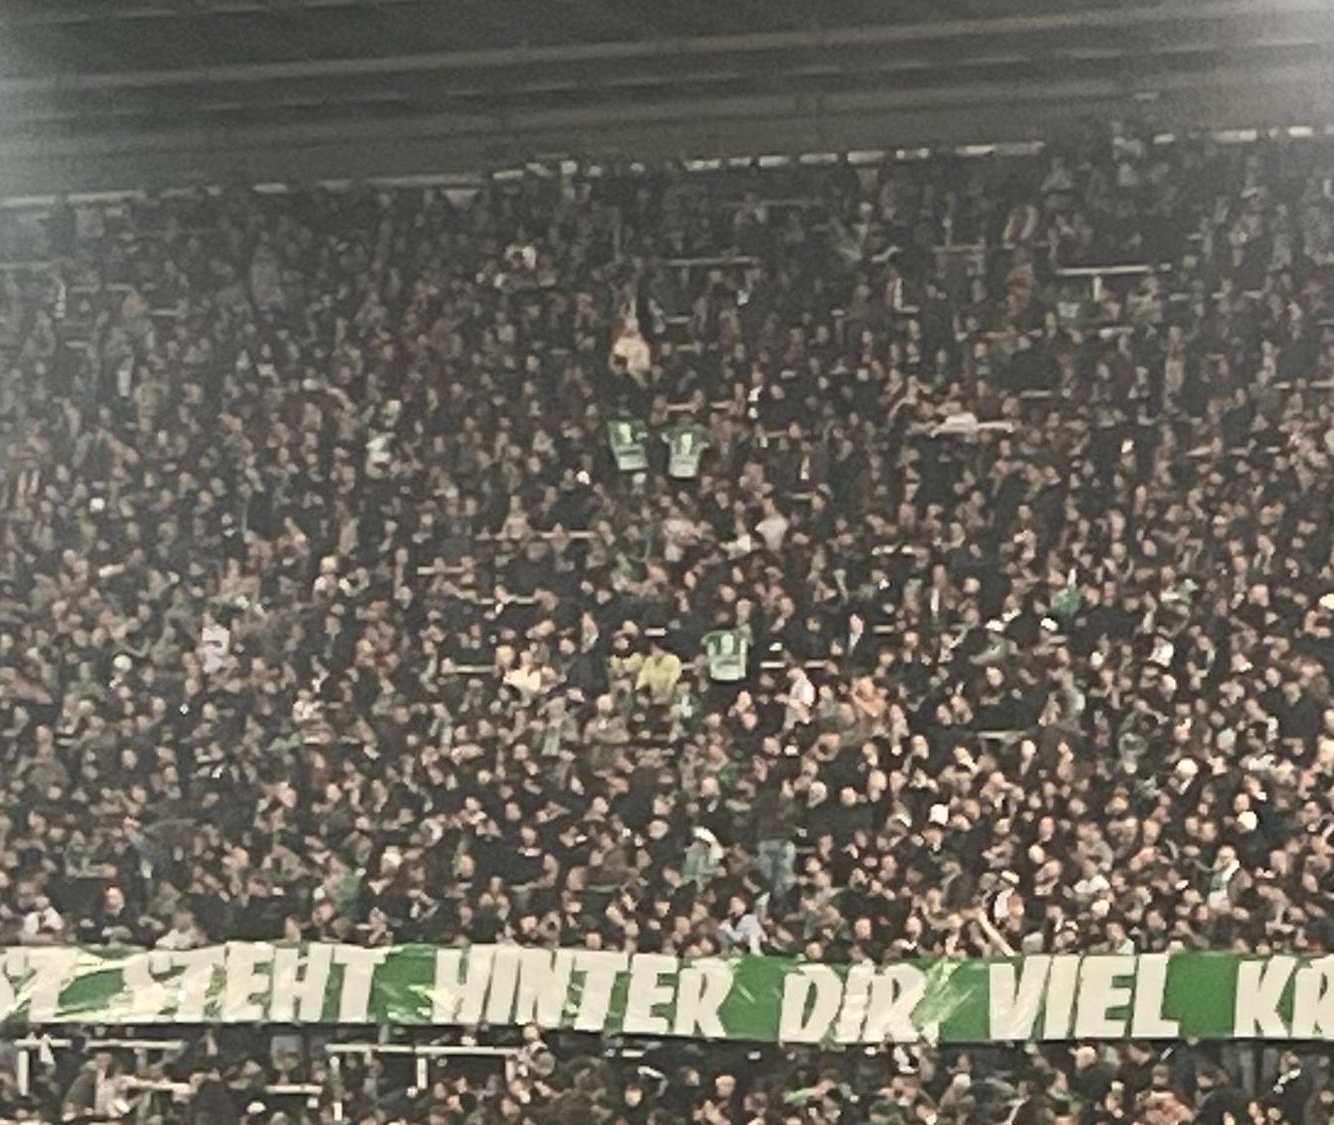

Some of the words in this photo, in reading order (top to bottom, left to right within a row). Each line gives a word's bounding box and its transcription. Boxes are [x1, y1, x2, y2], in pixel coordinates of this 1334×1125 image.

[431, 943, 737, 1038] HINTER
[777, 960, 937, 1043] DIR
[988, 952, 1180, 1039] VIEL
